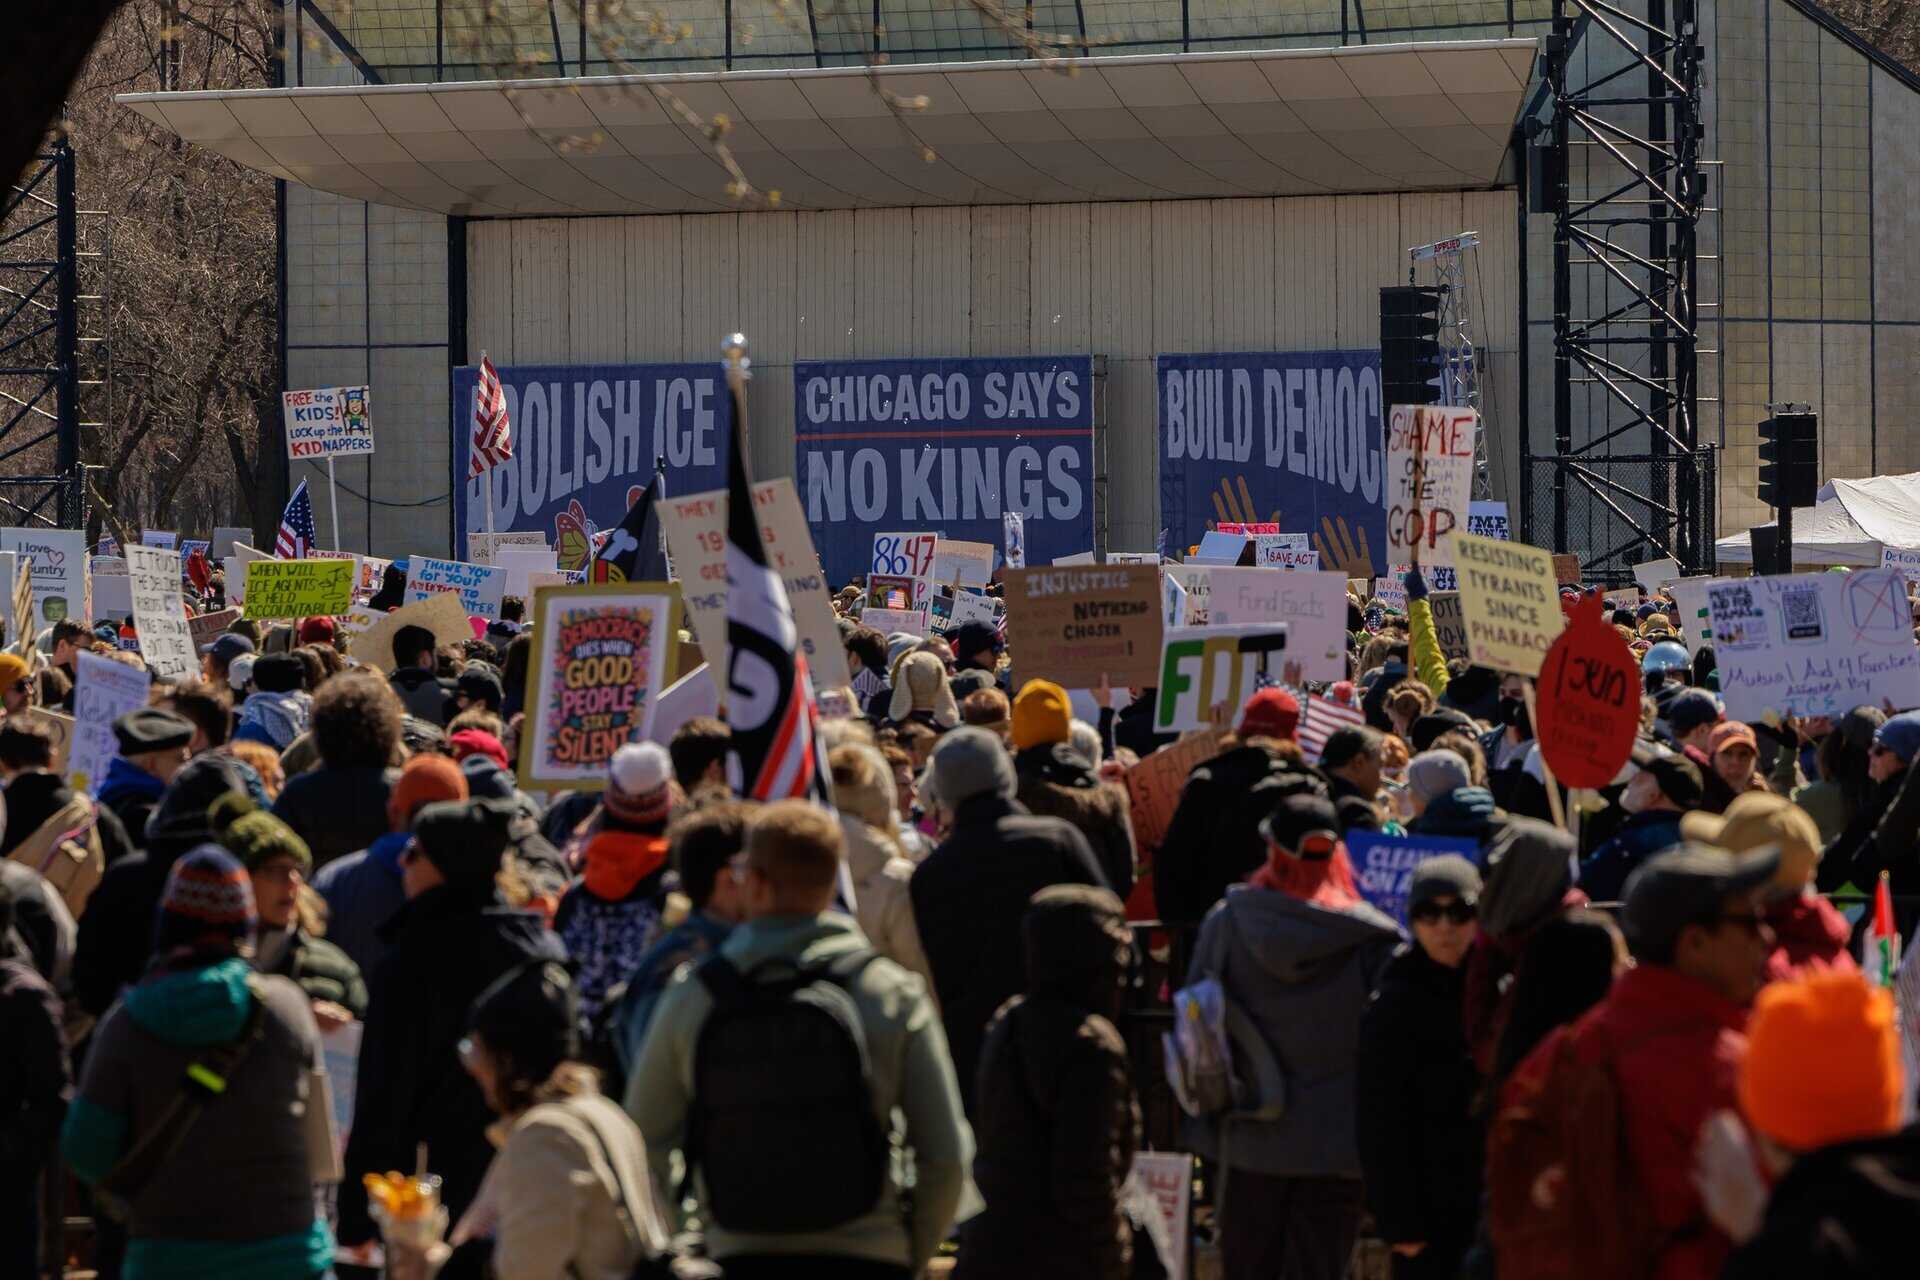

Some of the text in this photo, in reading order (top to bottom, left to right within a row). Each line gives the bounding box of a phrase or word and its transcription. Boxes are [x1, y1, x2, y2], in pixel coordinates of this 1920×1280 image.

[285, 392, 333, 406] FREE the
[806, 371, 1080, 424] CHICAGO SAYS
[295, 407, 339, 421] KIDS!
[653, 378, 715, 468] ICE
[290, 424, 343, 439] LOCK up the
[1166, 368, 1252, 463] BUILD
[1263, 366, 1388, 508] DEMOC
[1391, 412, 1473, 456] SHAME
[291, 439, 372, 456] KIDNAPPERS
[1405, 458, 1428, 477] ON
[808, 445, 1083, 522] NO KINGS
[1400, 479, 1435, 500] THE
[676, 500, 716, 518] THEY
[1388, 505, 1455, 549] GOP
[26, 542, 50, 553] love
[1269, 552, 1315, 565] SAVE ACT
[1458, 540, 1547, 576] RESISTING
[249, 563, 316, 576] WHEN WILL
[420, 569, 441, 581] for
[424, 559, 492, 578] THANK YOU
[249, 579, 317, 592] ICE AGENTS
[464, 588, 479, 599] TO
[1026, 571, 1129, 598] INJUSTICE
[1469, 569, 1547, 602] TYRANTS
[247, 592, 297, 604] BE HELD
[1073, 601, 1149, 620] NOTHING
[1432, 598, 1462, 618] OTE
[1486, 599, 1539, 626] SINCE
[560, 617, 647, 651] DEMOCRACY
[601, 640, 633, 656] WHEN
[566, 656, 632, 689] GOOD
[561, 684, 636, 719] PEOPLE
